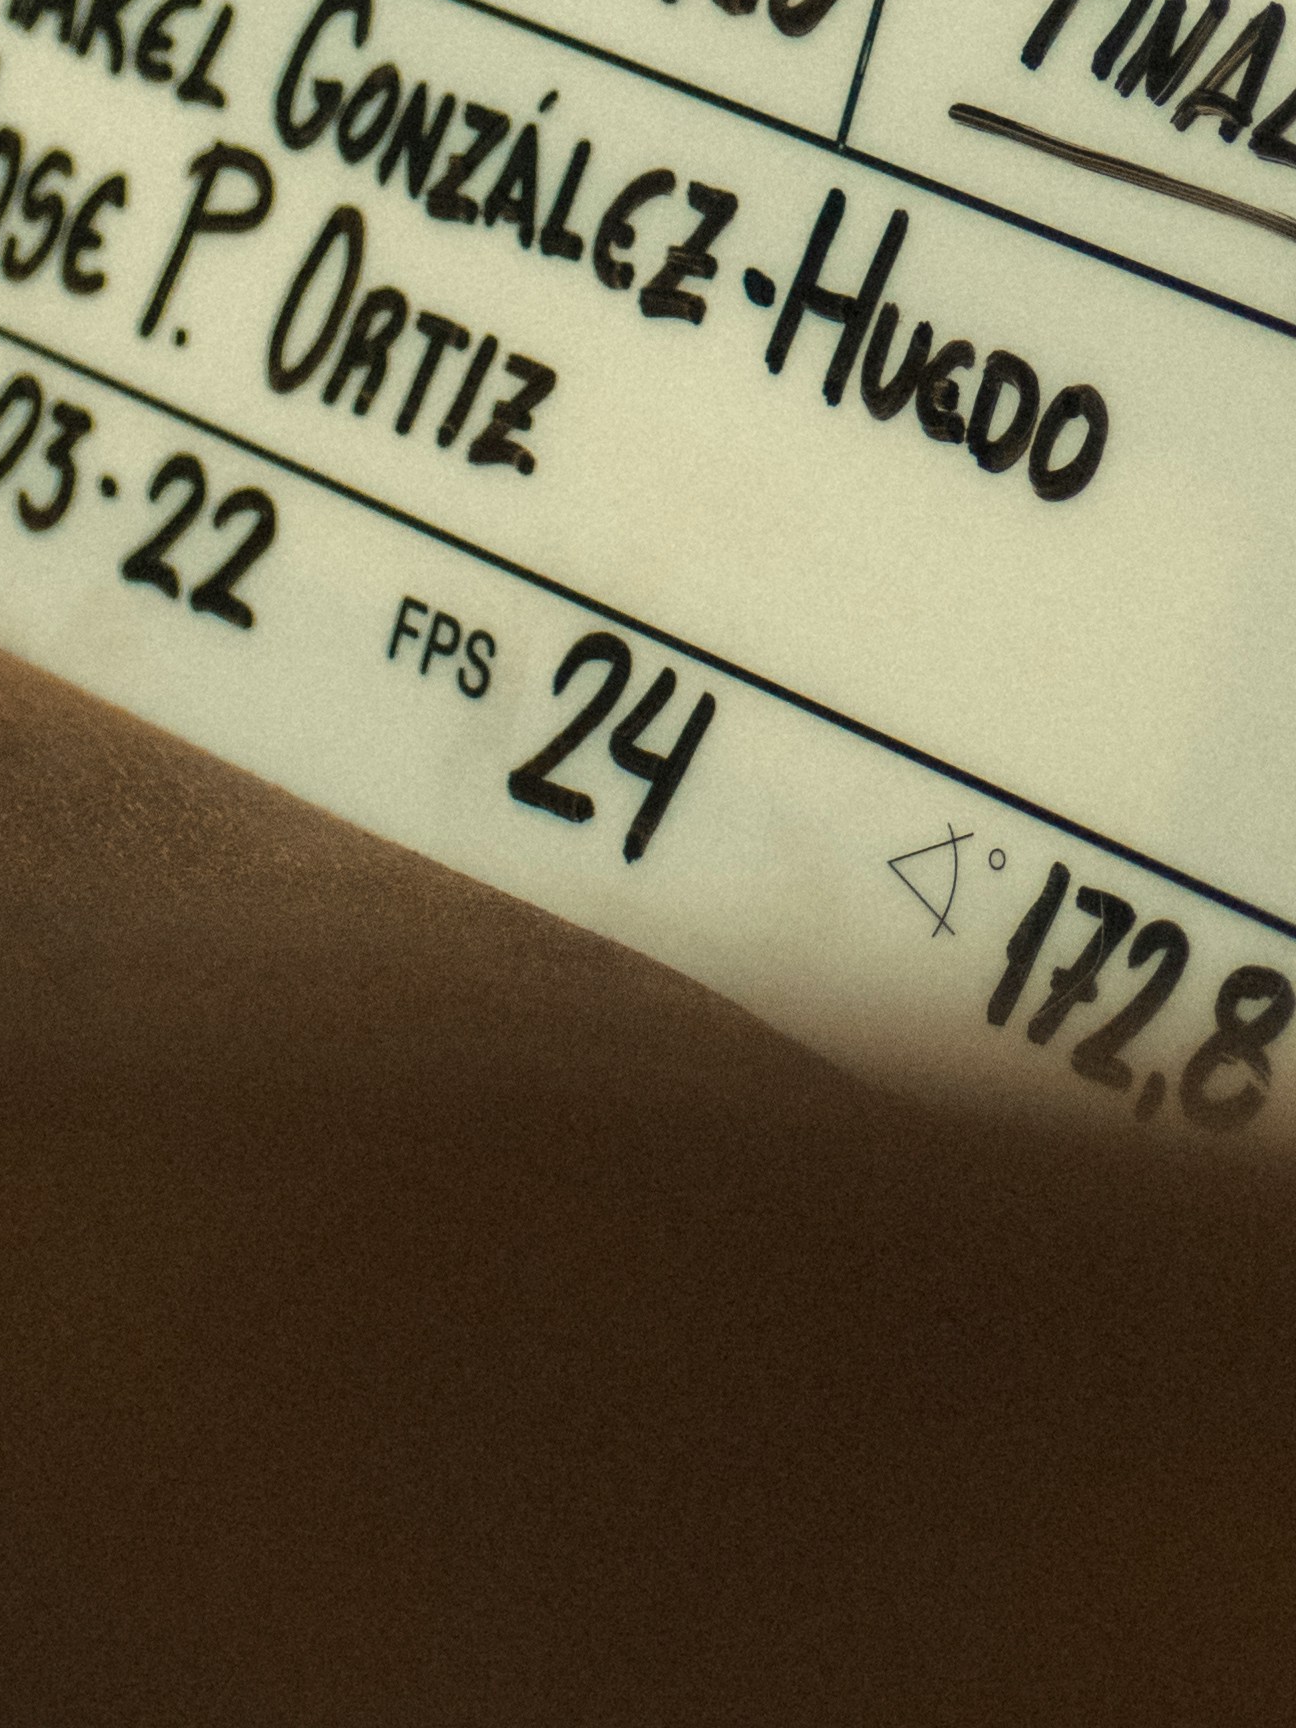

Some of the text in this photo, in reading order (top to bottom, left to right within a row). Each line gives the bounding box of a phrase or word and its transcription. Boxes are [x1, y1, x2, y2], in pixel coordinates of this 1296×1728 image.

[140, 142, 273, 347] P.
[266, 205, 557, 475] ORTIZ
[388, 596, 497, 698] FPS
[509, 631, 715, 864] 24
[987, 862, 1296, 1133] 172,8
